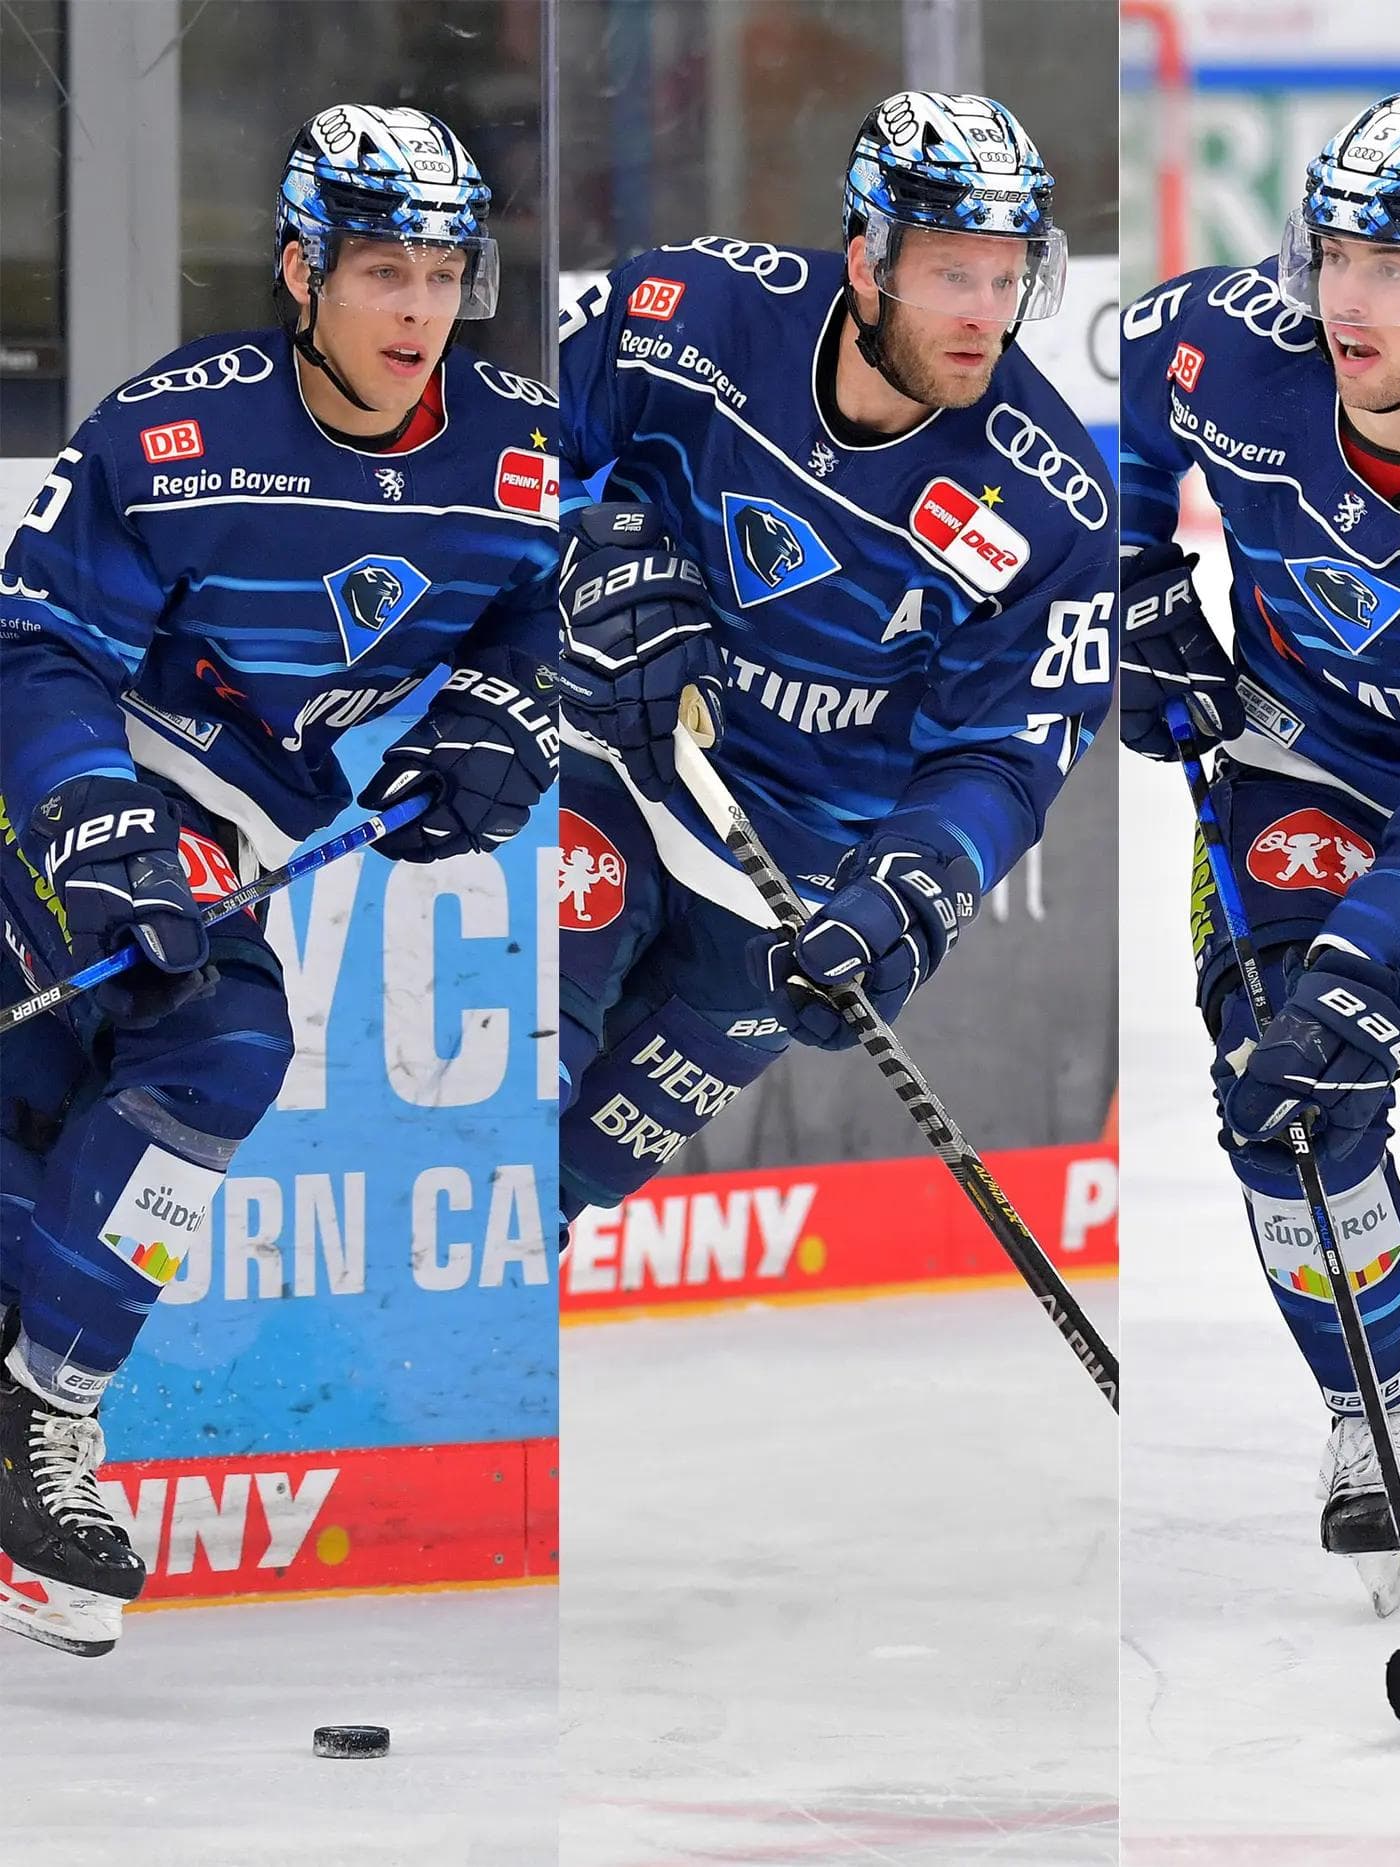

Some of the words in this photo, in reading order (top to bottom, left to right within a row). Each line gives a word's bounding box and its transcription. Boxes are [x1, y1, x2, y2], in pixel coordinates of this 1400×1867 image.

[409, 139, 440, 155] 25
[969, 127, 1004, 143] 86
[1374, 127, 1396, 141] 5
[969, 188, 1030, 204] BAUER
[634, 283, 675, 312] DB
[620, 329, 673, 359] Regio
[677, 345, 748, 410] Bayern
[149, 427, 195, 457] DB
[1203, 419, 1286, 466] Bayern
[152, 469, 222, 497] Regio
[230, 467, 312, 495] Bayern
[960, 528, 1018, 572] DEL
[572, 557, 708, 616] BAUE
[881, 589, 923, 645] A
[1031, 592, 1115, 689] 86
[720, 647, 890, 733] TURN
[46, 808, 156, 884] UER
[1244, 957, 1262, 995] WAGNER
[12, 986, 62, 1022] BAUER
[590, 1092, 694, 1164] BRÄ
[411, 1164, 550, 1292] CA
[559, 1183, 827, 1297] ENNY.
[1313, 1205, 1333, 1250] NEXUS
[1326, 1249, 1341, 1275] GEO
